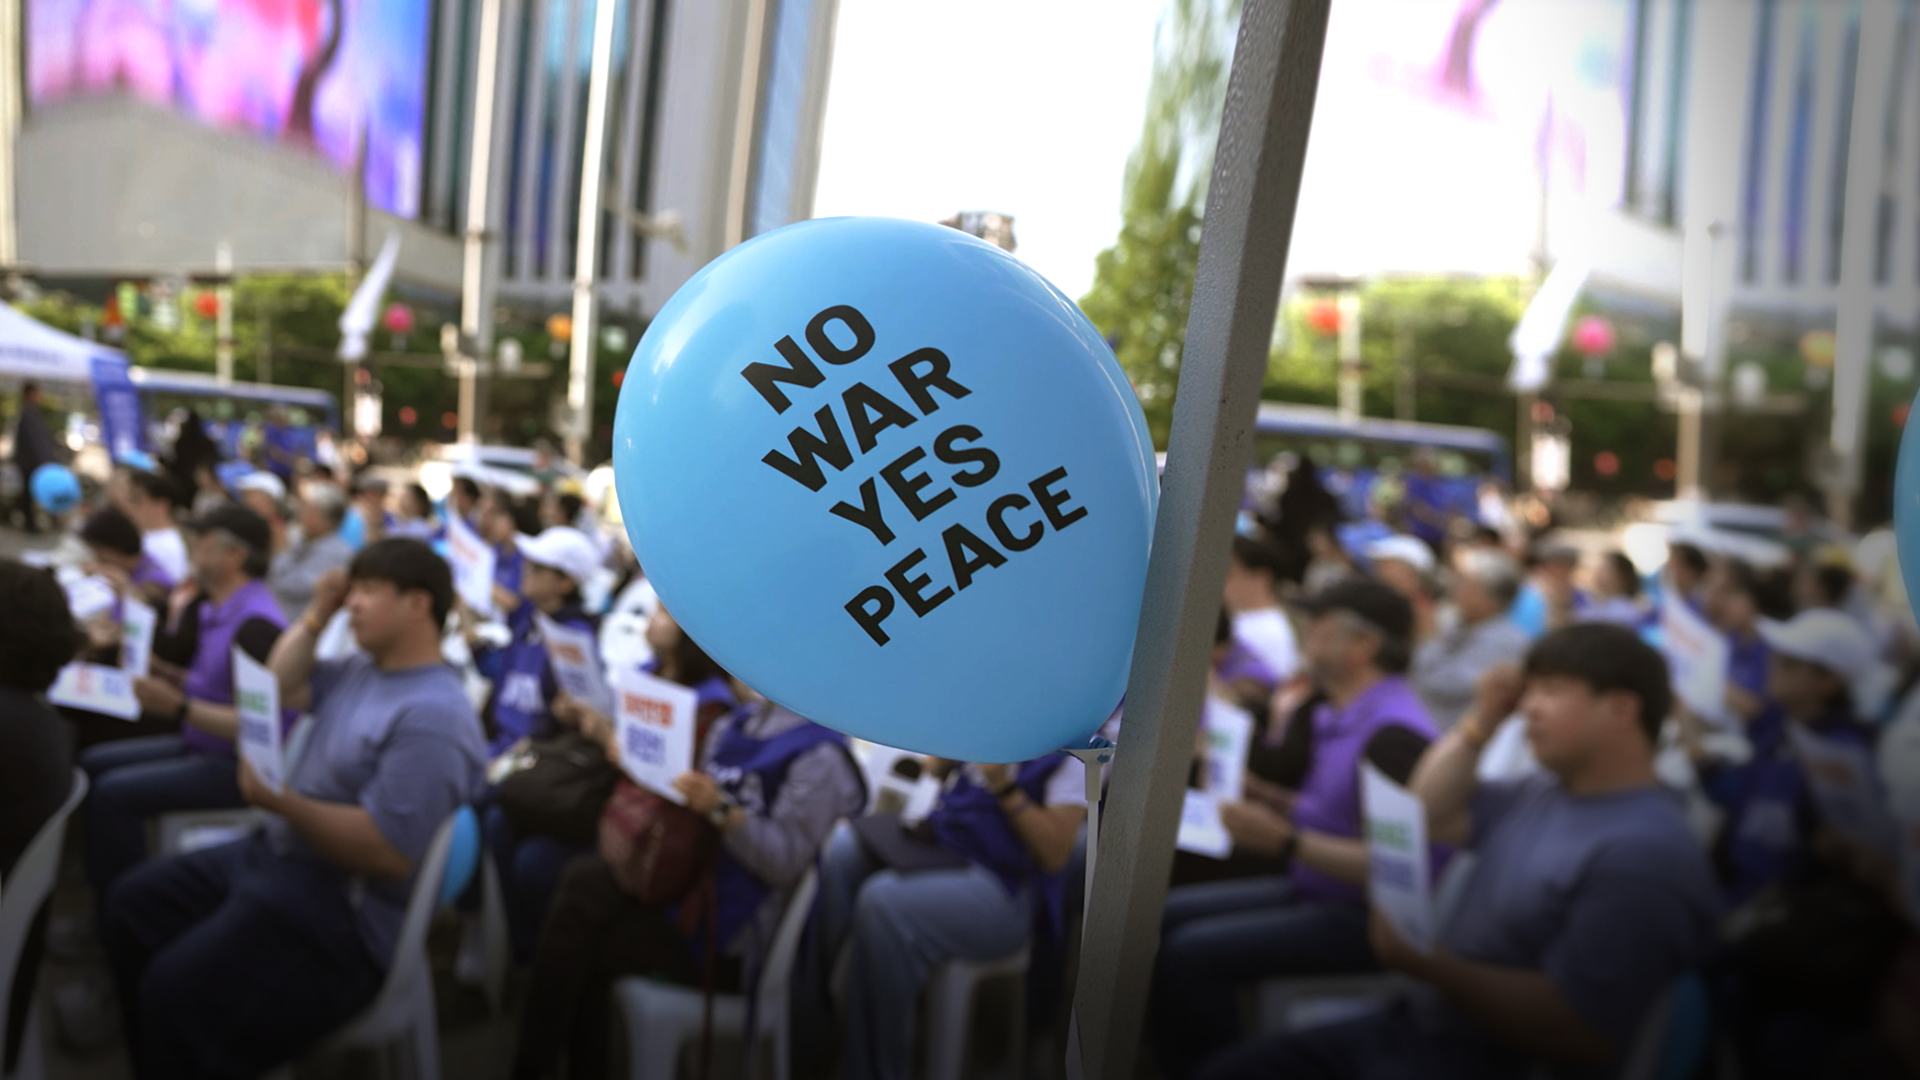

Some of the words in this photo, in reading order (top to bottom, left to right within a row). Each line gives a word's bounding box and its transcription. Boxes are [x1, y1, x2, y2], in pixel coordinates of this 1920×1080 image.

[742, 306, 875, 415] NO
[762, 348, 972, 492] WAR
[830, 425, 1000, 546] YES
[844, 467, 1088, 646] PEACE
